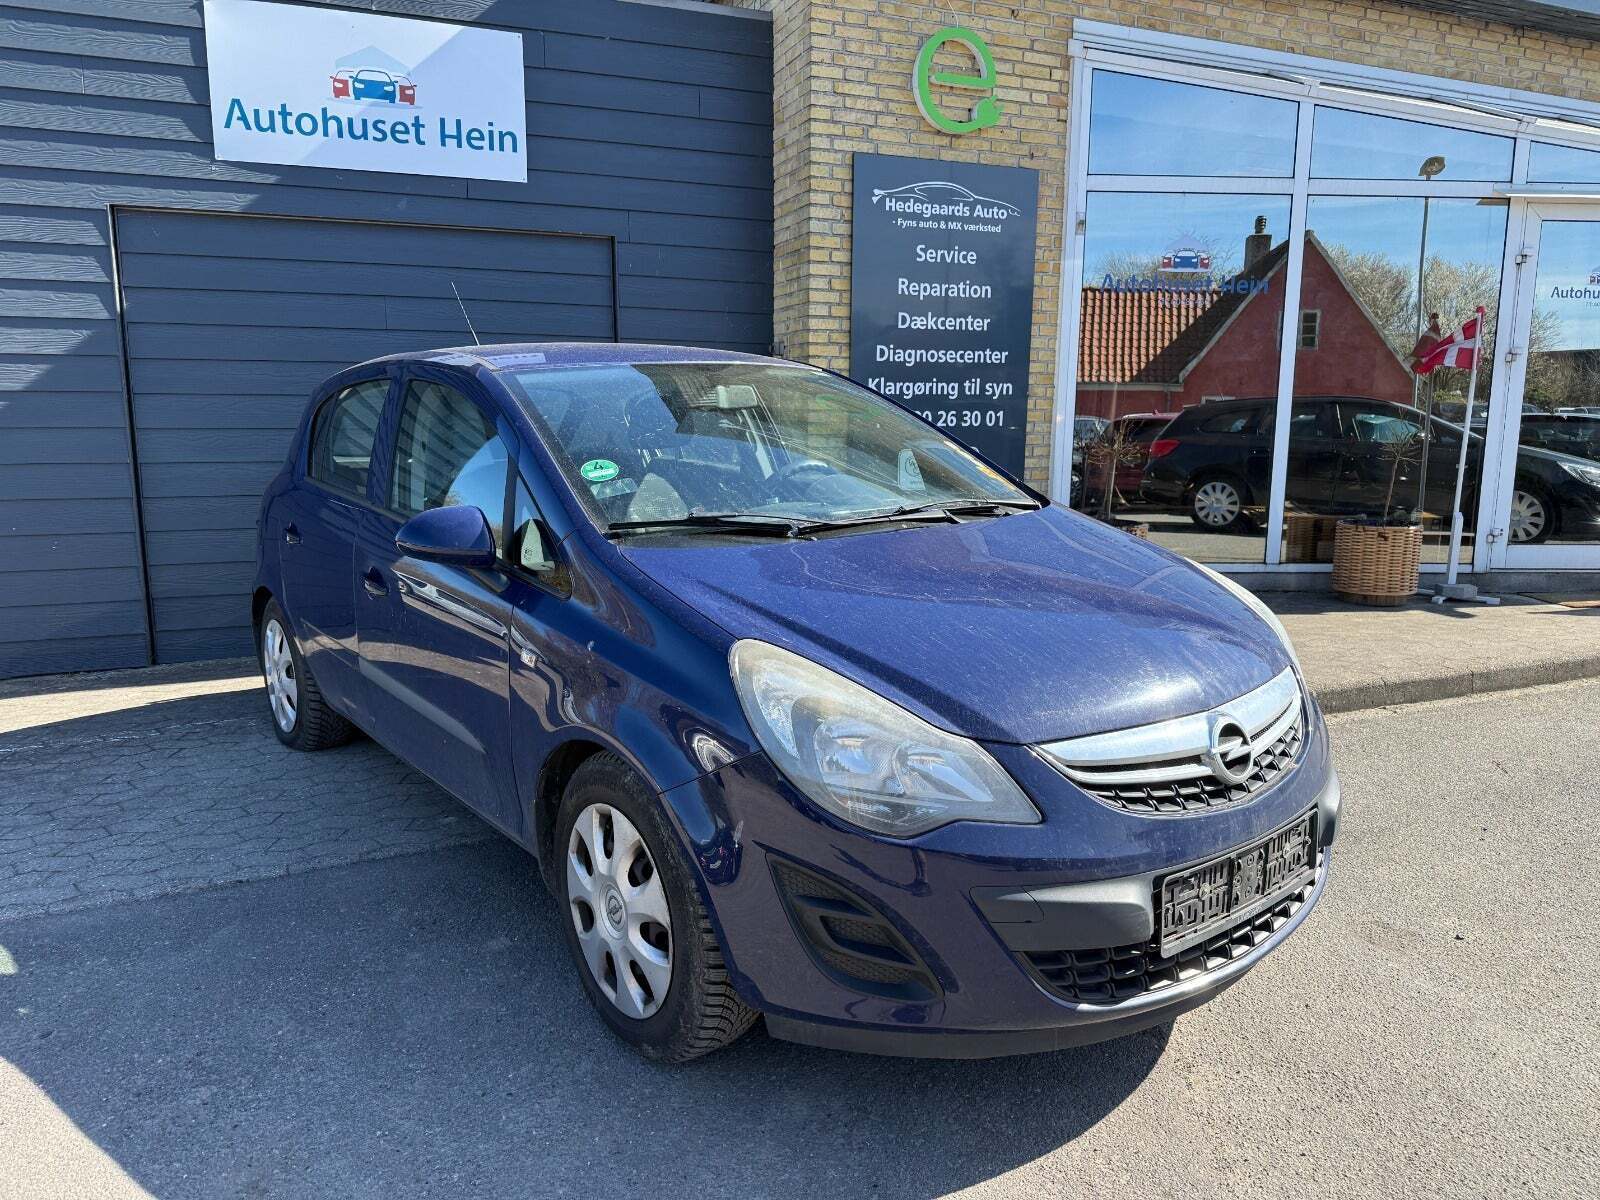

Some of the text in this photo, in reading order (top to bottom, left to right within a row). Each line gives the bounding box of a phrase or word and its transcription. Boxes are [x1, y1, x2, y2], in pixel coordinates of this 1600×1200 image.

[223, 98, 519, 153] Autohuset Hein
[885, 197, 1008, 219] Hedegaards Auto
[897, 218, 1001, 233] Fyns auto & MX værksted
[916, 244, 977, 264] Service
[898, 277, 992, 301] Reparation
[1101, 273, 1269, 295] Autohuset Hein
[897, 311, 991, 331] Dækcenter
[876, 344, 1009, 367] Diagnosecenter
[868, 377, 1013, 400] Klargøring til syn
[914, 410, 1004, 427] 0 26 30 01
